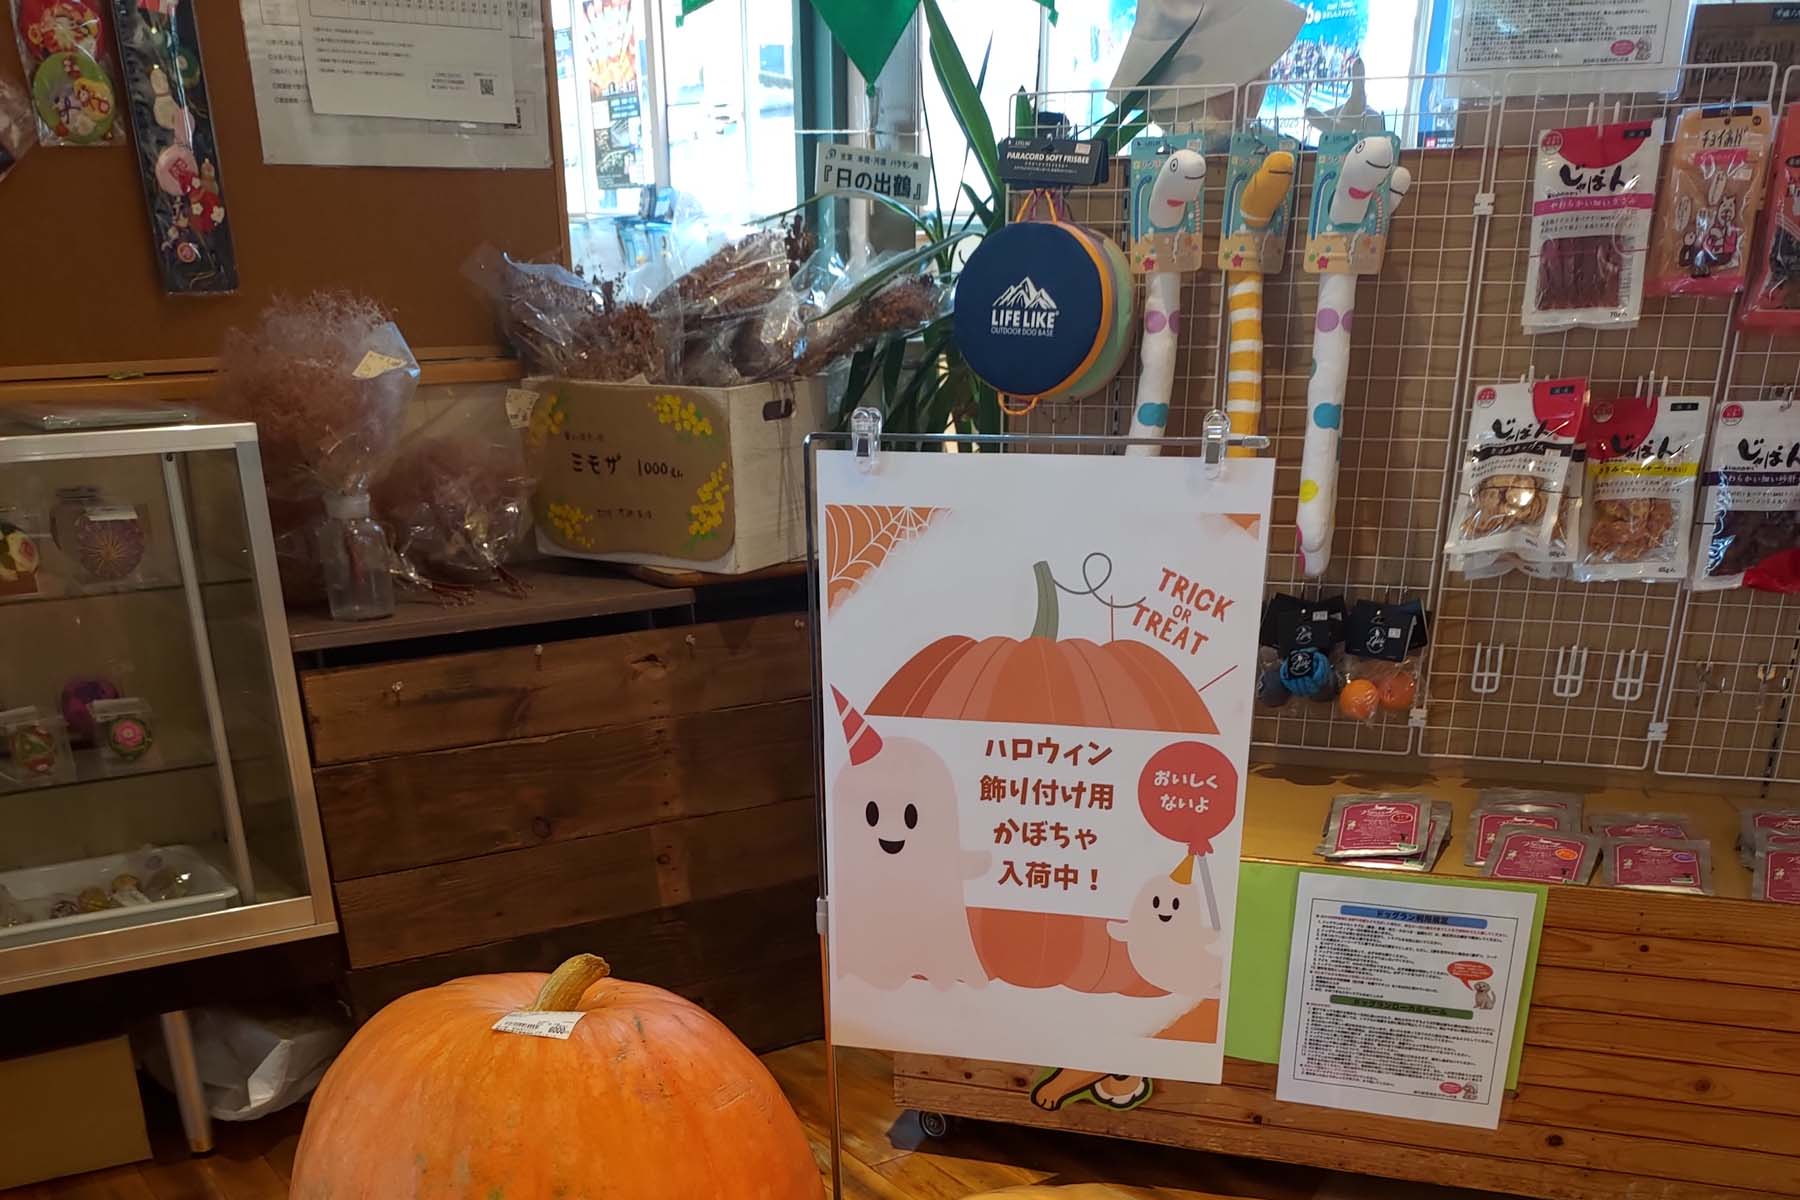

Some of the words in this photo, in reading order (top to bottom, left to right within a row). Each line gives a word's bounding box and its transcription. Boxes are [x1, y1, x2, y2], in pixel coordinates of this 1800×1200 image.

[1006, 152, 1044, 161] PARACORD
[1045, 153, 1063, 162] SOFT
[1063, 155, 1090, 164] FRISBEE
[991, 309, 1020, 327] LIFE
[1023, 310, 1056, 328] LIKE
[991, 326, 1021, 336] OUTDOOR
[1022, 328, 1037, 336] DOG
[1038, 329, 1054, 337] BASE
[571, 451, 622, 475] ミモザ
[1158, 567, 1235, 623] TRICK
[1172, 603, 1193, 622] OR
[1132, 602, 1209, 656] TREAT
[1154, 769, 1219, 790] おいしく
[979, 774, 1114, 812] 飾り付け用
[1160, 793, 1210, 814] ないよ
[993, 818, 1098, 851] かぼちゃ
